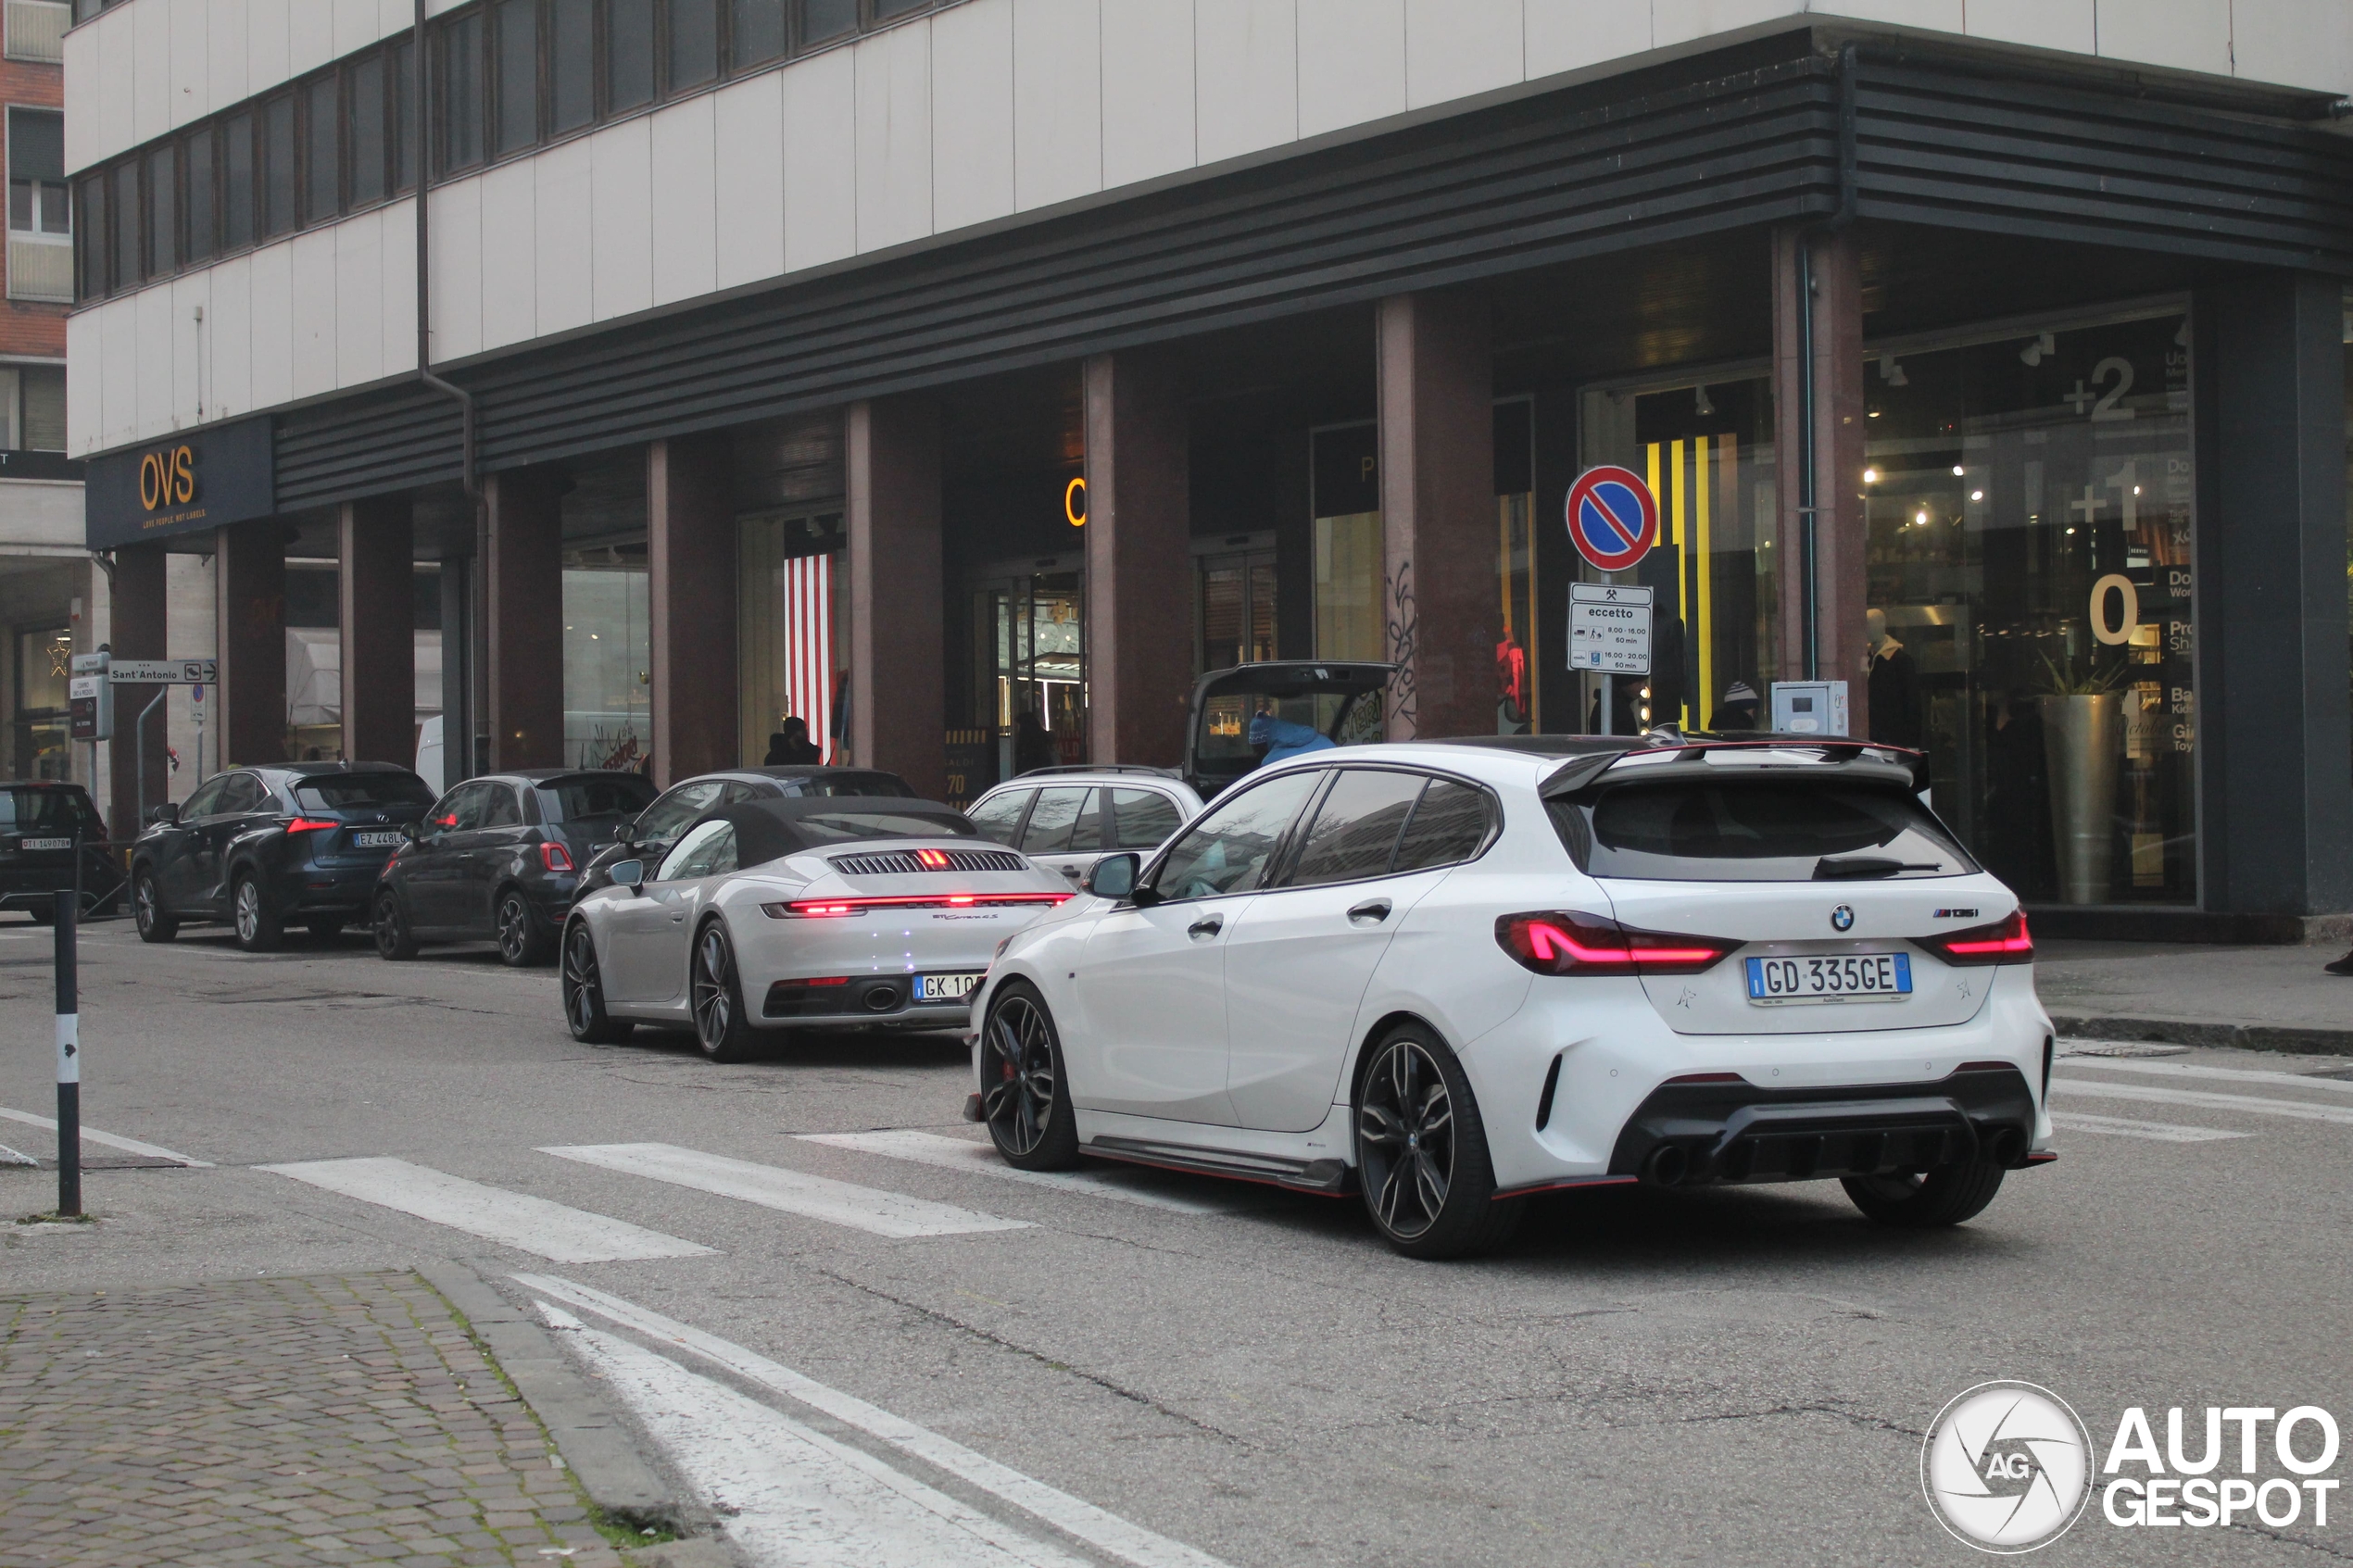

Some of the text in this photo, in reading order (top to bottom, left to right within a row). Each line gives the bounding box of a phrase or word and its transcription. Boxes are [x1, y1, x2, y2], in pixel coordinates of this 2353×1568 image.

[0, 453, 8, 465] T
[140, 445, 194, 511] OVS
[1361, 456, 1374, 483] P
[1589, 608, 1633, 619] eccetto
[2089, 573, 2138, 646] 0
[2170, 636, 2193, 650] Sh
[947, 774, 965, 795] 70
[360, 834, 372, 845] EZ
[1766, 960, 1799, 993] GD
[1808, 958, 1893, 991] 335GE
[926, 977, 946, 996] GK
